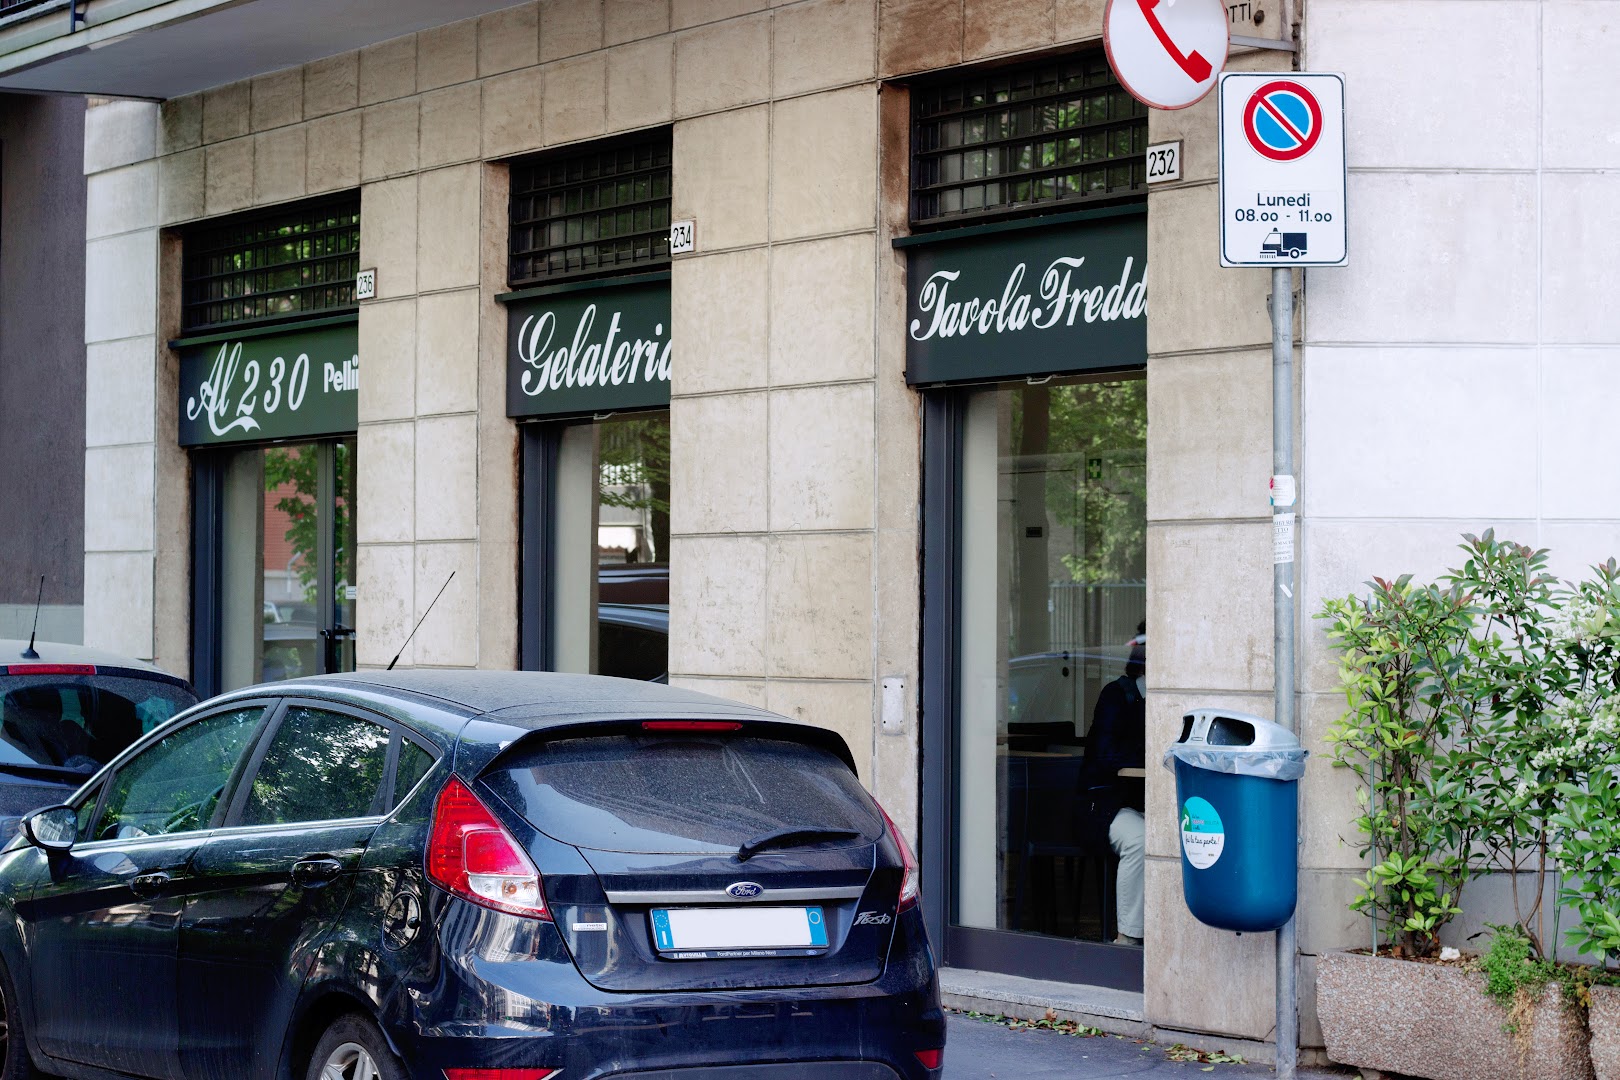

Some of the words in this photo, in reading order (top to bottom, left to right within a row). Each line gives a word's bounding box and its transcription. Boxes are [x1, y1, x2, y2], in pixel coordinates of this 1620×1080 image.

[1225, 3, 1251, 23] TTI
[1149, 149, 1175, 177] 232
[1257, 193, 1311, 207] Lunedi
[672, 225, 692, 249] 234
[358, 275, 373, 295] 236
[910, 262, 1032, 341] Tavola
[1031, 256, 1147, 329] Fredd
[187, 341, 261, 437] Al
[236, 353, 310, 417] 230
[734, 884, 759, 897] Ford
[853, 911, 892, 926] Fiesta
